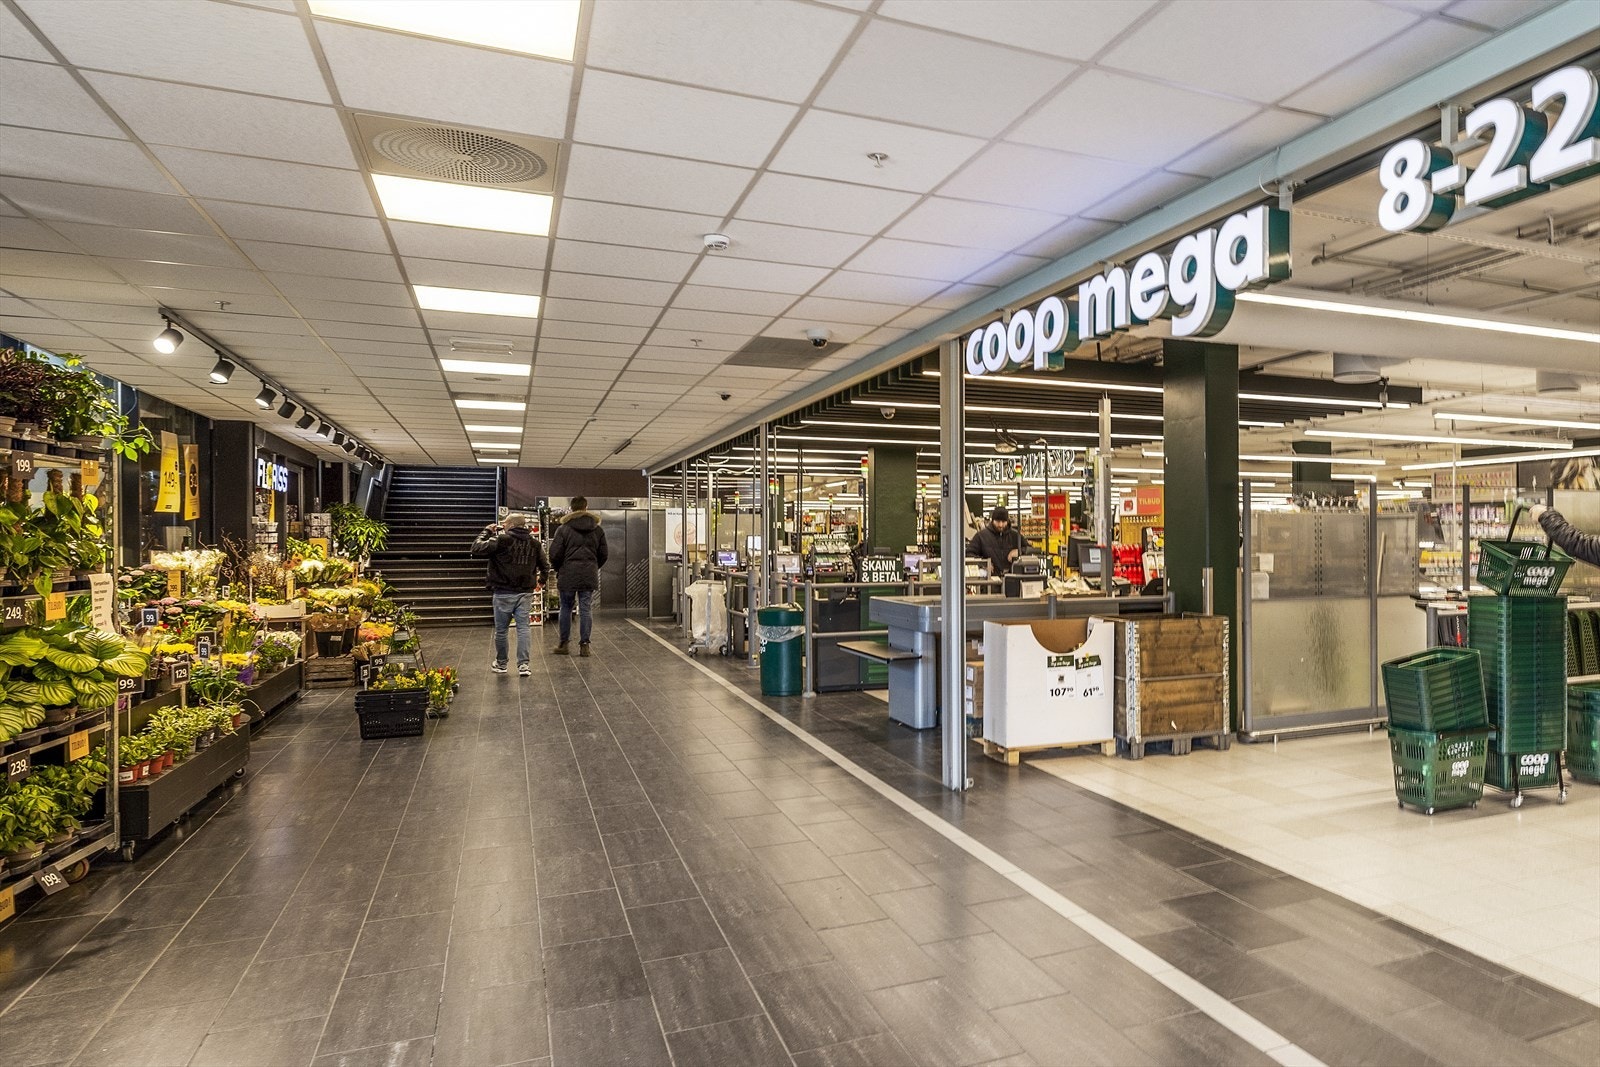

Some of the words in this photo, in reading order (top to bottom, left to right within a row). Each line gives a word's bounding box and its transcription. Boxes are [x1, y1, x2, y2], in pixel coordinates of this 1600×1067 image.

[1378, 65, 1597, 232] 8-22
[966, 296, 1068, 375] coop
[1078, 205, 1269, 339] mega
[538, 500, 545, 508] 3
[862, 560, 896, 571] SKANN
[862, 571, 870, 583] &
[872, 571, 903, 583] BETAL
[1526, 566, 1556, 578] coop
[1523, 576, 1549, 588] mega
[1521, 753, 1549, 767] coop
[1520, 764, 1546, 777] mega
